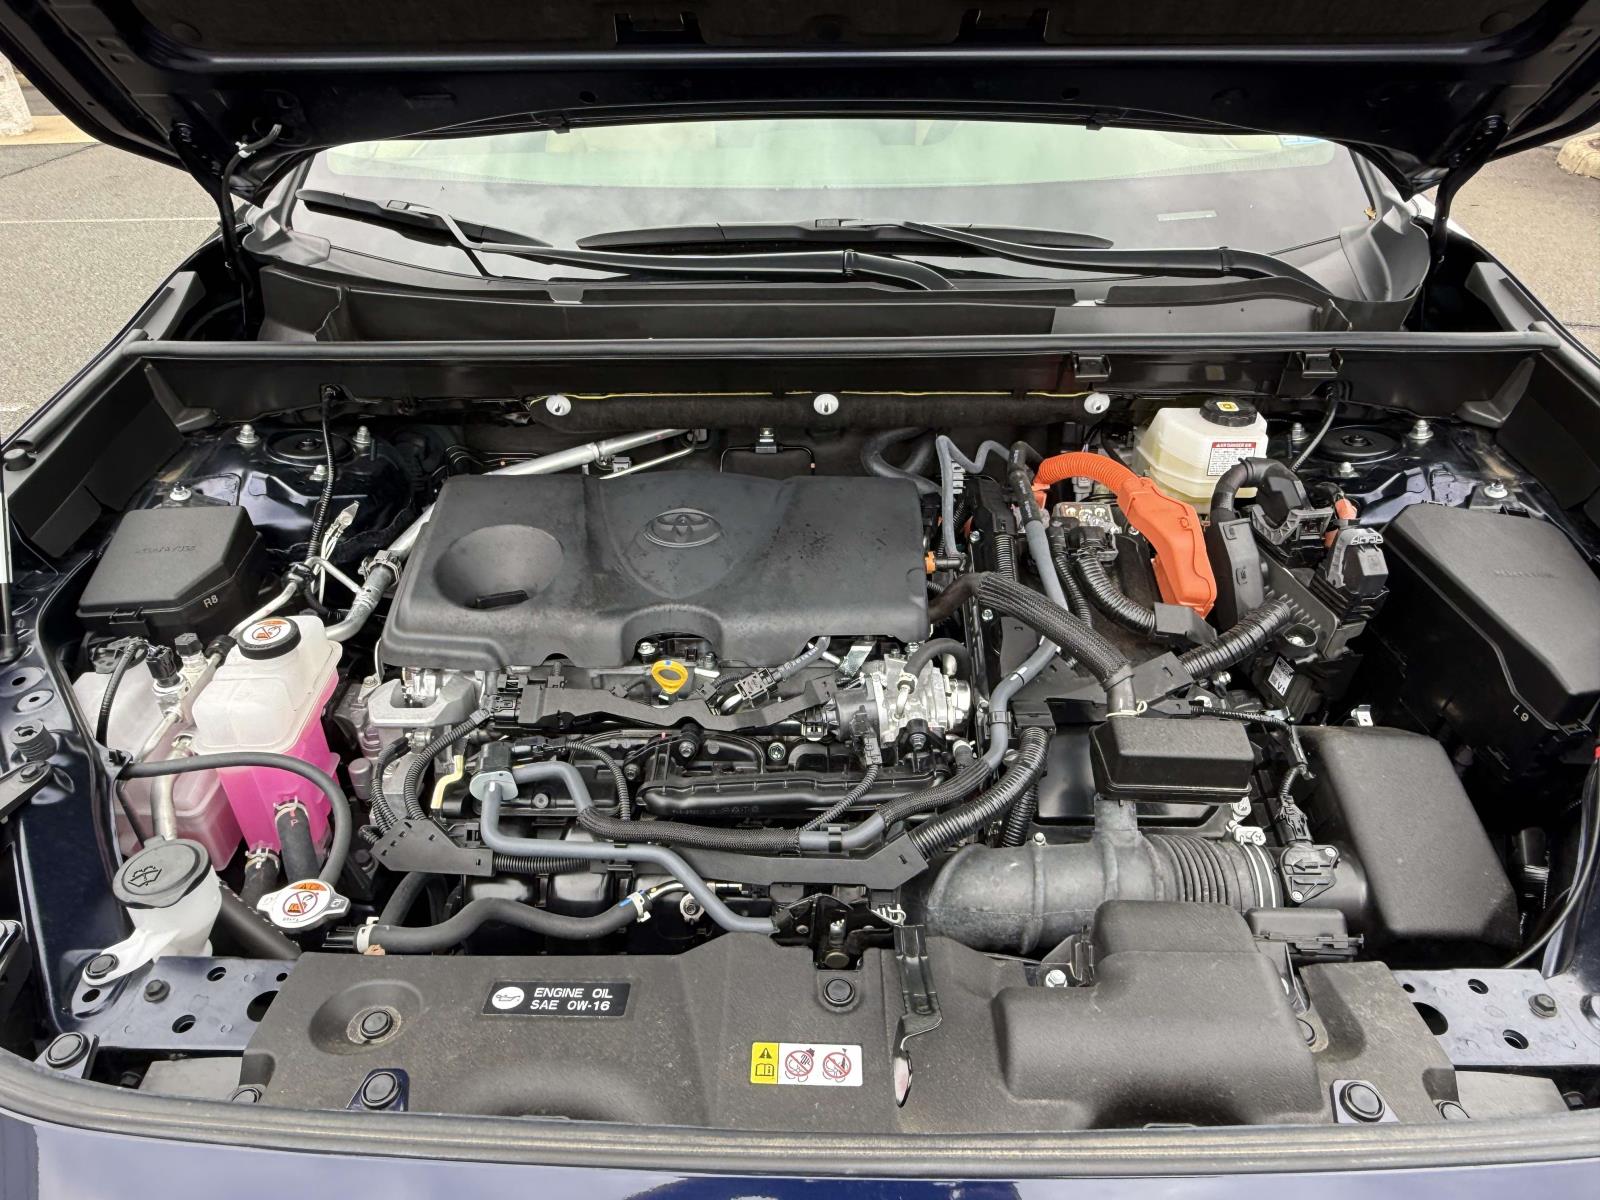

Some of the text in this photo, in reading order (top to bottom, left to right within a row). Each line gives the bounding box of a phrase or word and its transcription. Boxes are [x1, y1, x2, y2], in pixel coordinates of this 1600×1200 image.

[203, 594, 219, 609] R8
[533, 987, 614, 1000] ENGINE OIL
[529, 999, 560, 1011] SAE
